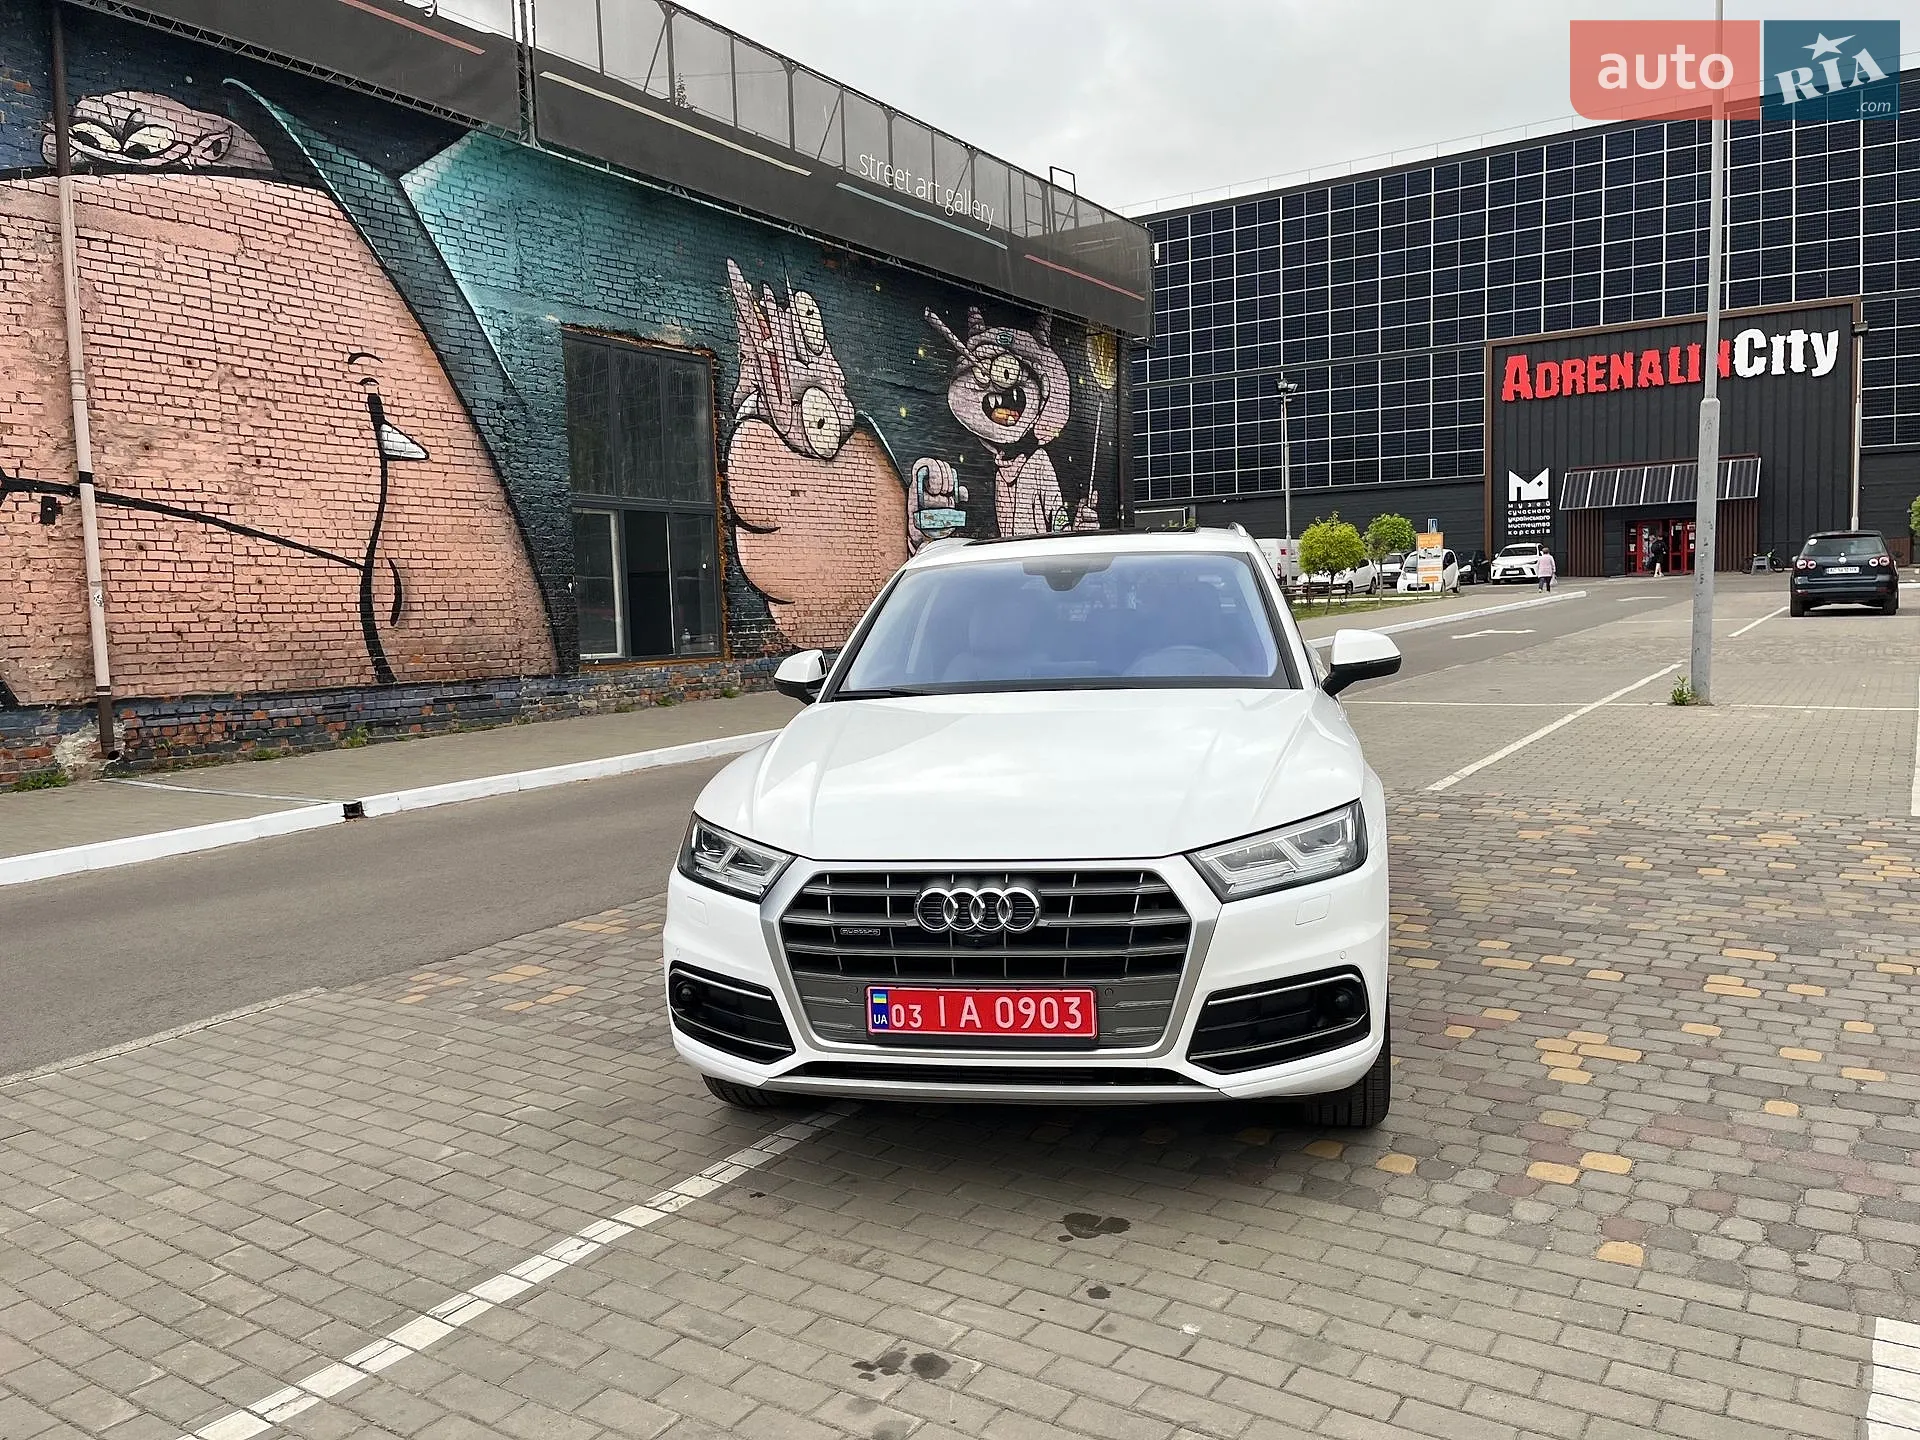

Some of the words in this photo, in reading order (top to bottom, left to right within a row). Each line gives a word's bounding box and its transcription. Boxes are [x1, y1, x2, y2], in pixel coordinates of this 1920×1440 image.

[859, 153, 912, 193] street
[915, 177, 941, 204] art
[944, 187, 995, 231] gallery
[1507, 508, 1551, 516] сучасного
[873, 1013, 888, 1025] UA
[891, 1004, 923, 1028] 03
[995, 996, 1082, 1030] 0903
